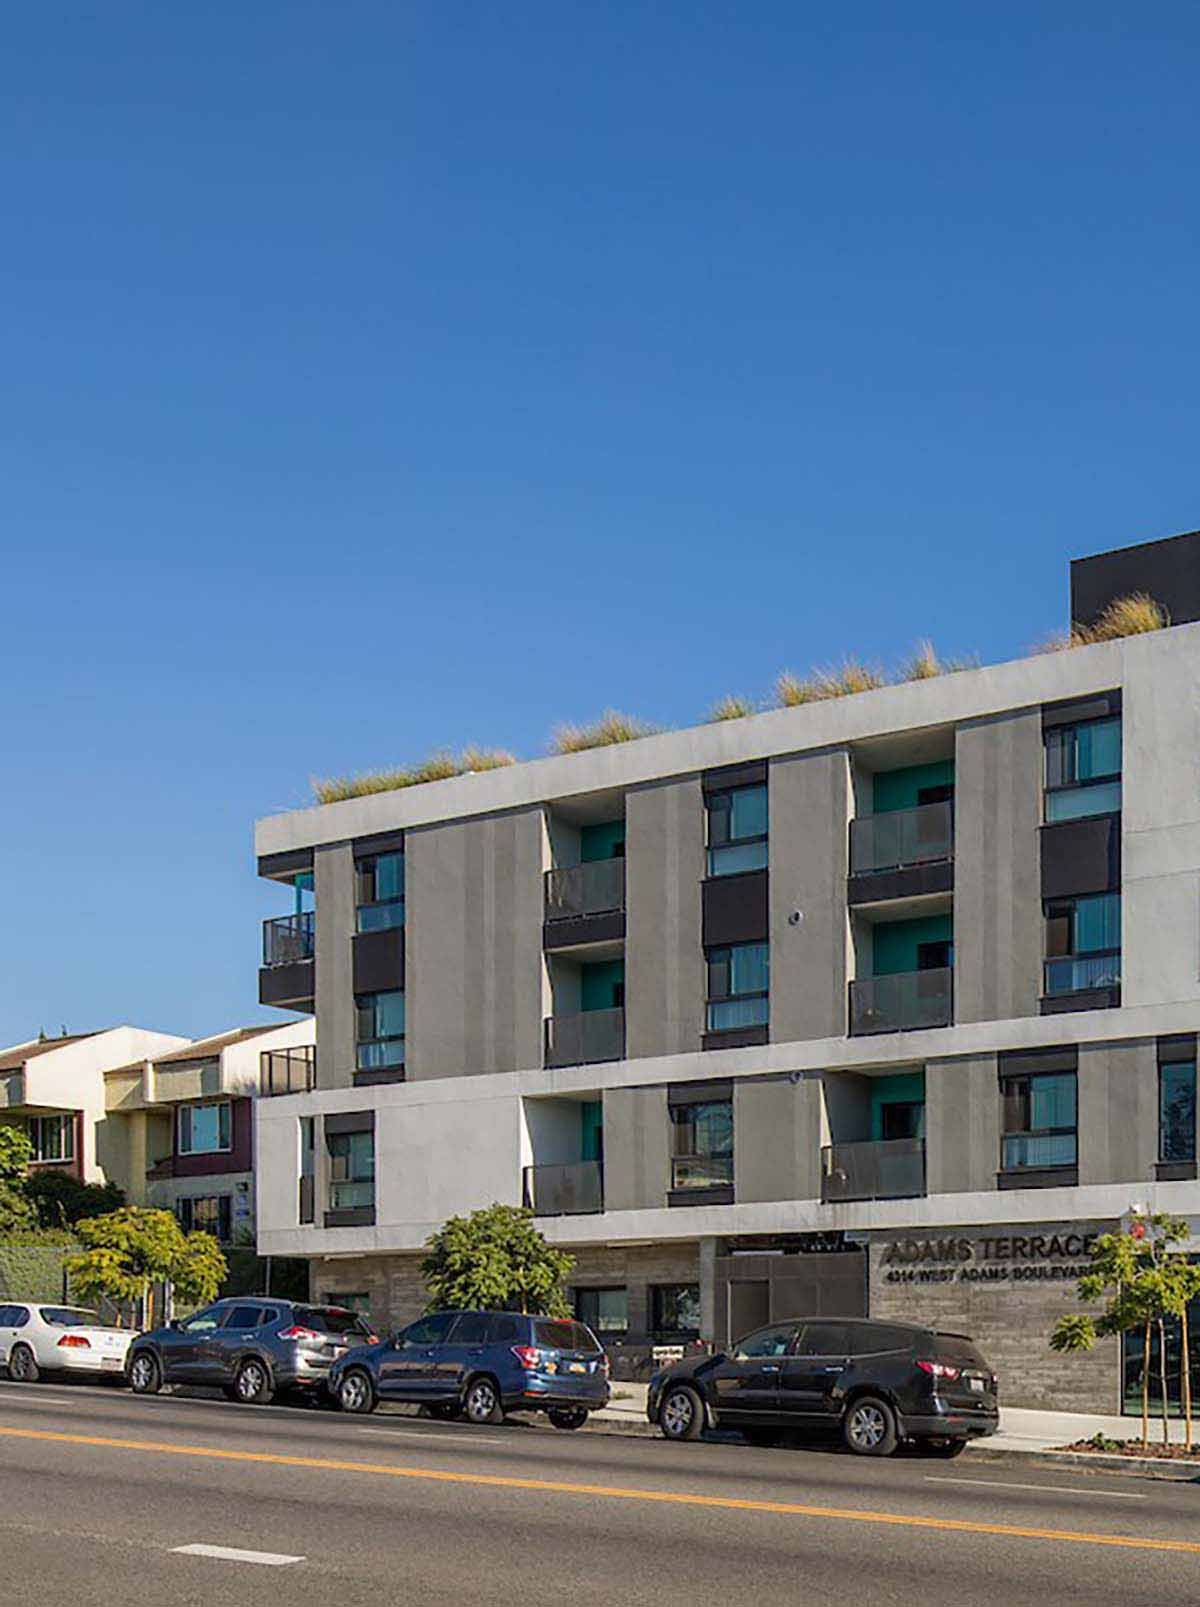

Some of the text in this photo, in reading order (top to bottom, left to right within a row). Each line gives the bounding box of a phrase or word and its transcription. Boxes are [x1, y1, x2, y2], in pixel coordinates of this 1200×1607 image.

[883, 1233, 1098, 1264] ADAMS TERRACE
[917, 1268, 956, 1282] WEST
[960, 1266, 1009, 1281] ADAMS
